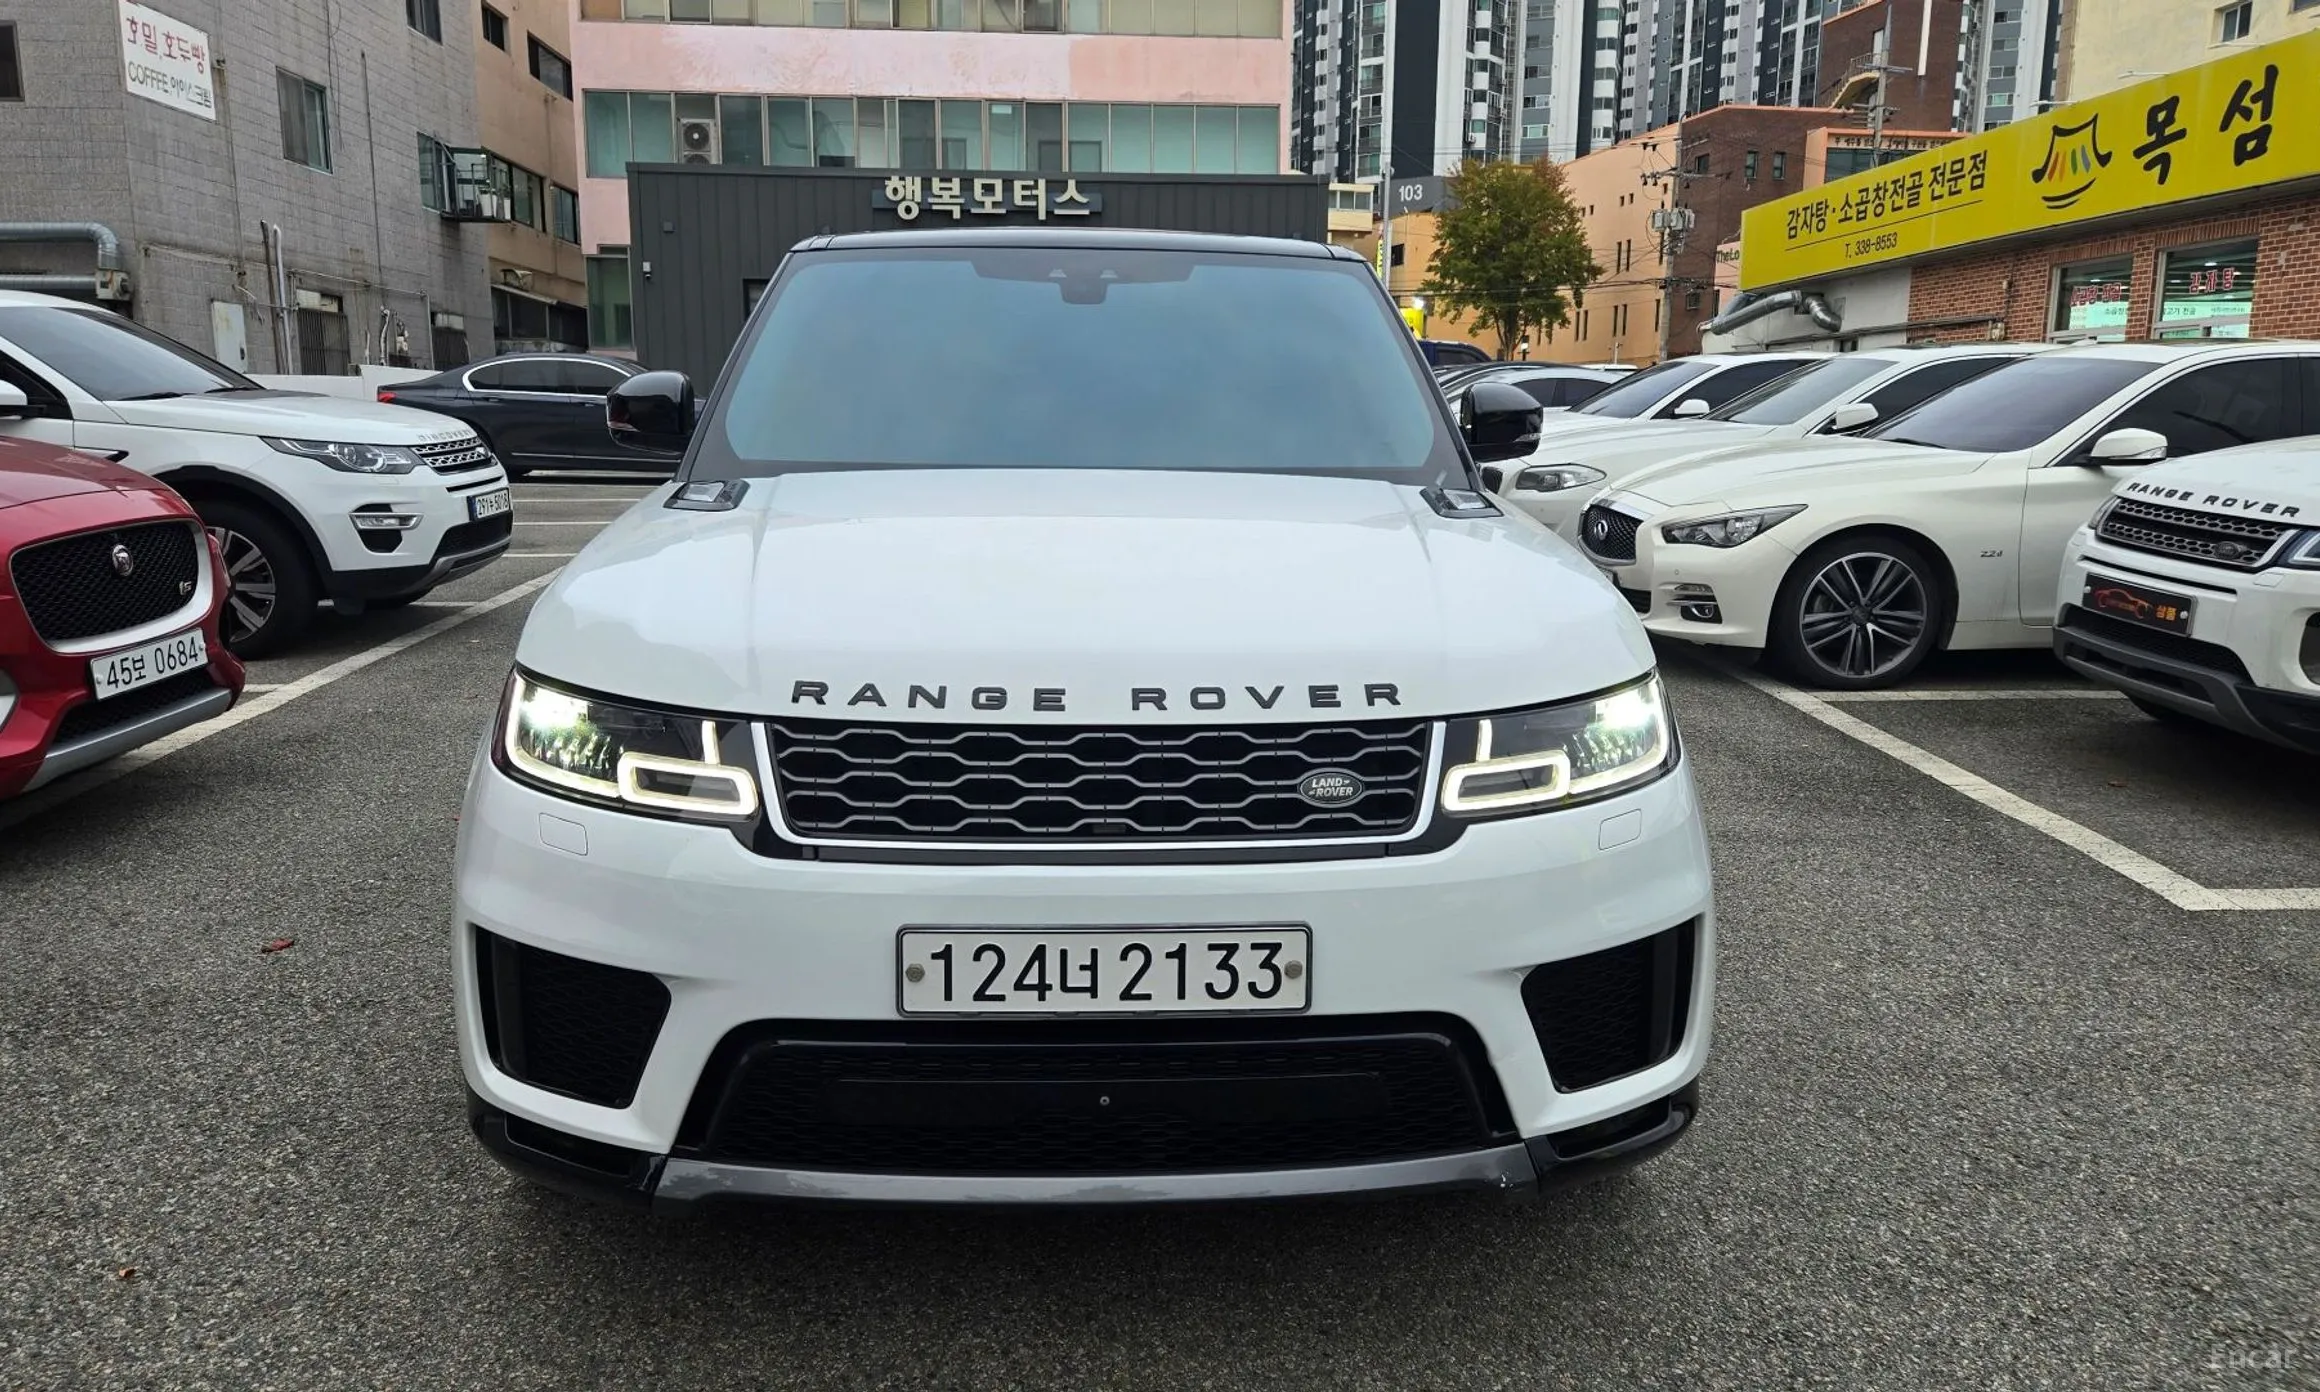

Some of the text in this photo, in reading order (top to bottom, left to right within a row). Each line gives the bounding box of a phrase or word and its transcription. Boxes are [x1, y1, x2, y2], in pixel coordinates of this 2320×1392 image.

[1929, 150, 1988, 201] 전문점
[885, 175, 1090, 220] 행복모터스
[1399, 184, 1423, 202] 103
[1855, 232, 1898, 257] 338-8553
[2127, 482, 2300, 517] RANGE ROVER
[107, 636, 198, 688] 45보 0684
[791, 680, 1402, 713] RANGE ROVER
[1312, 777, 1342, 788] LAND
[1316, 786, 1353, 797] ROVER
[930, 943, 1283, 1001] 124너 2133
